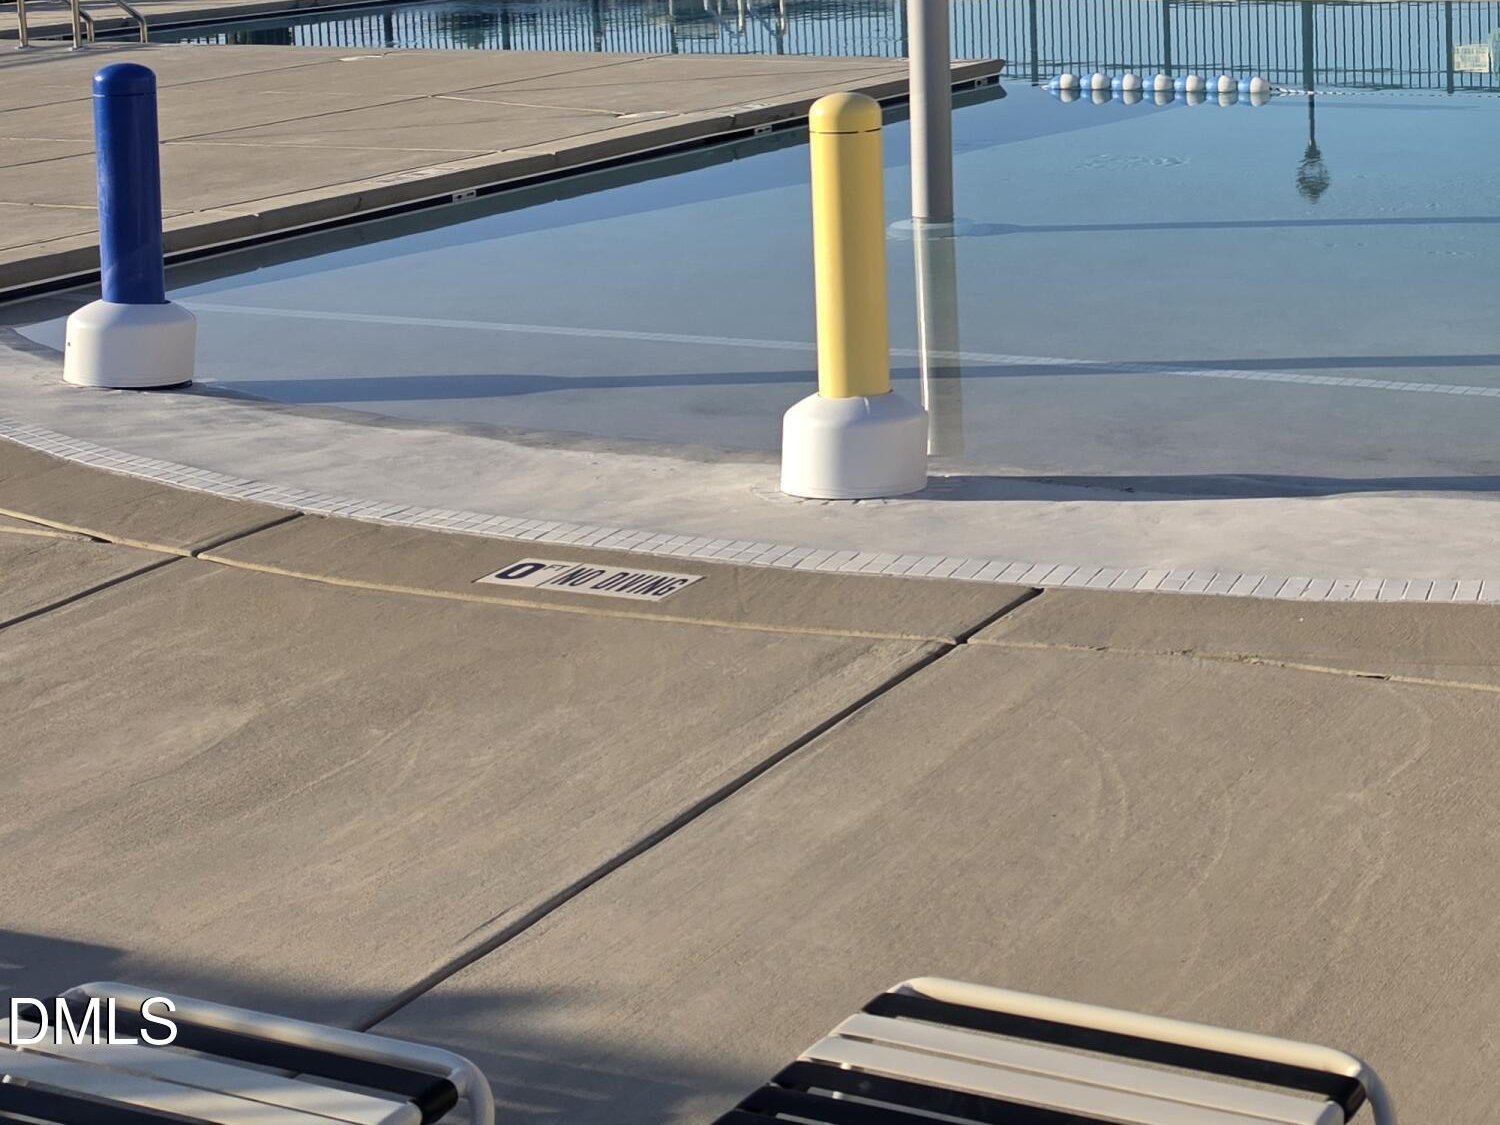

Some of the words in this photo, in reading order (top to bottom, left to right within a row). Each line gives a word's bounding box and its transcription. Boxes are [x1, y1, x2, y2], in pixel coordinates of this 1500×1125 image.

[495, 562, 546, 580] 0
[543, 564, 569, 573] FT
[550, 567, 605, 587] NO
[589, 571, 689, 597] DIVING
